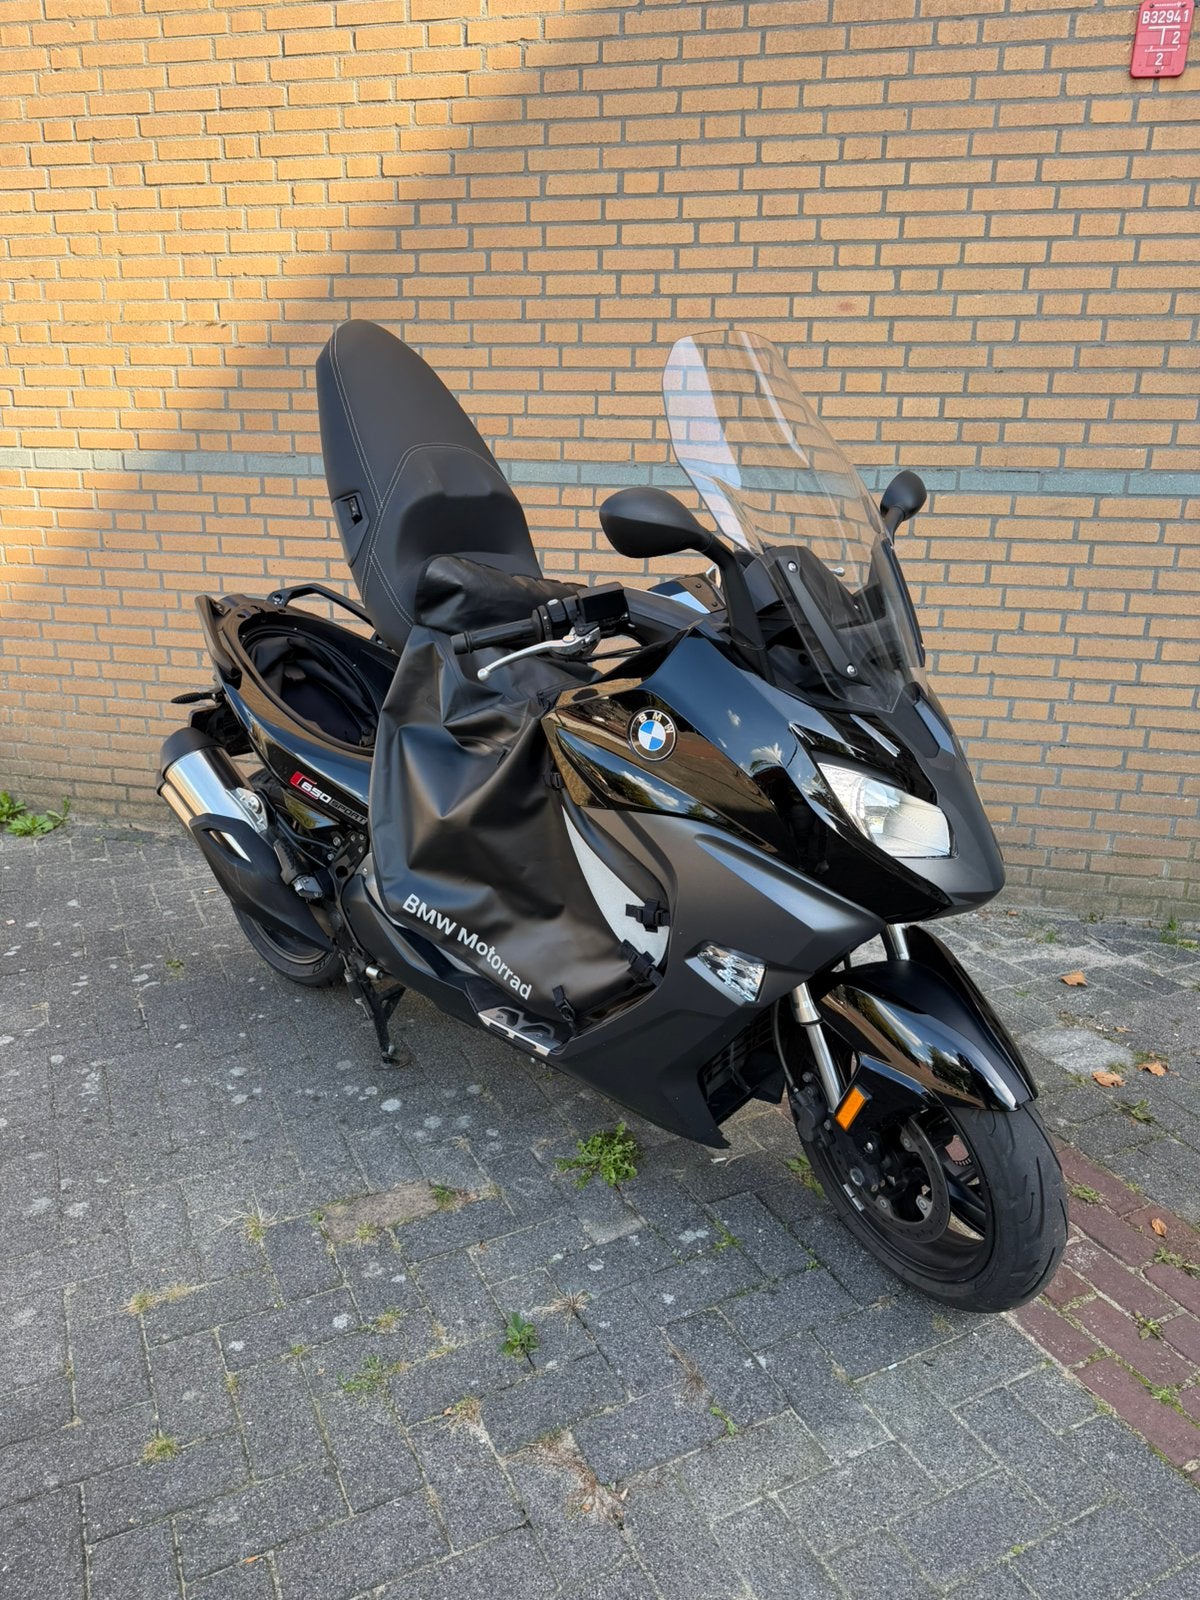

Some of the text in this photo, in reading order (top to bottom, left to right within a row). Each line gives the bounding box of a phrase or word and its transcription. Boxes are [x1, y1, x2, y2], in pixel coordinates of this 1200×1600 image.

[1142, 10, 1189, 24] B32941
[639, 712, 674, 733] BMW
[402, 893, 533, 1000] BMW Motorrad
